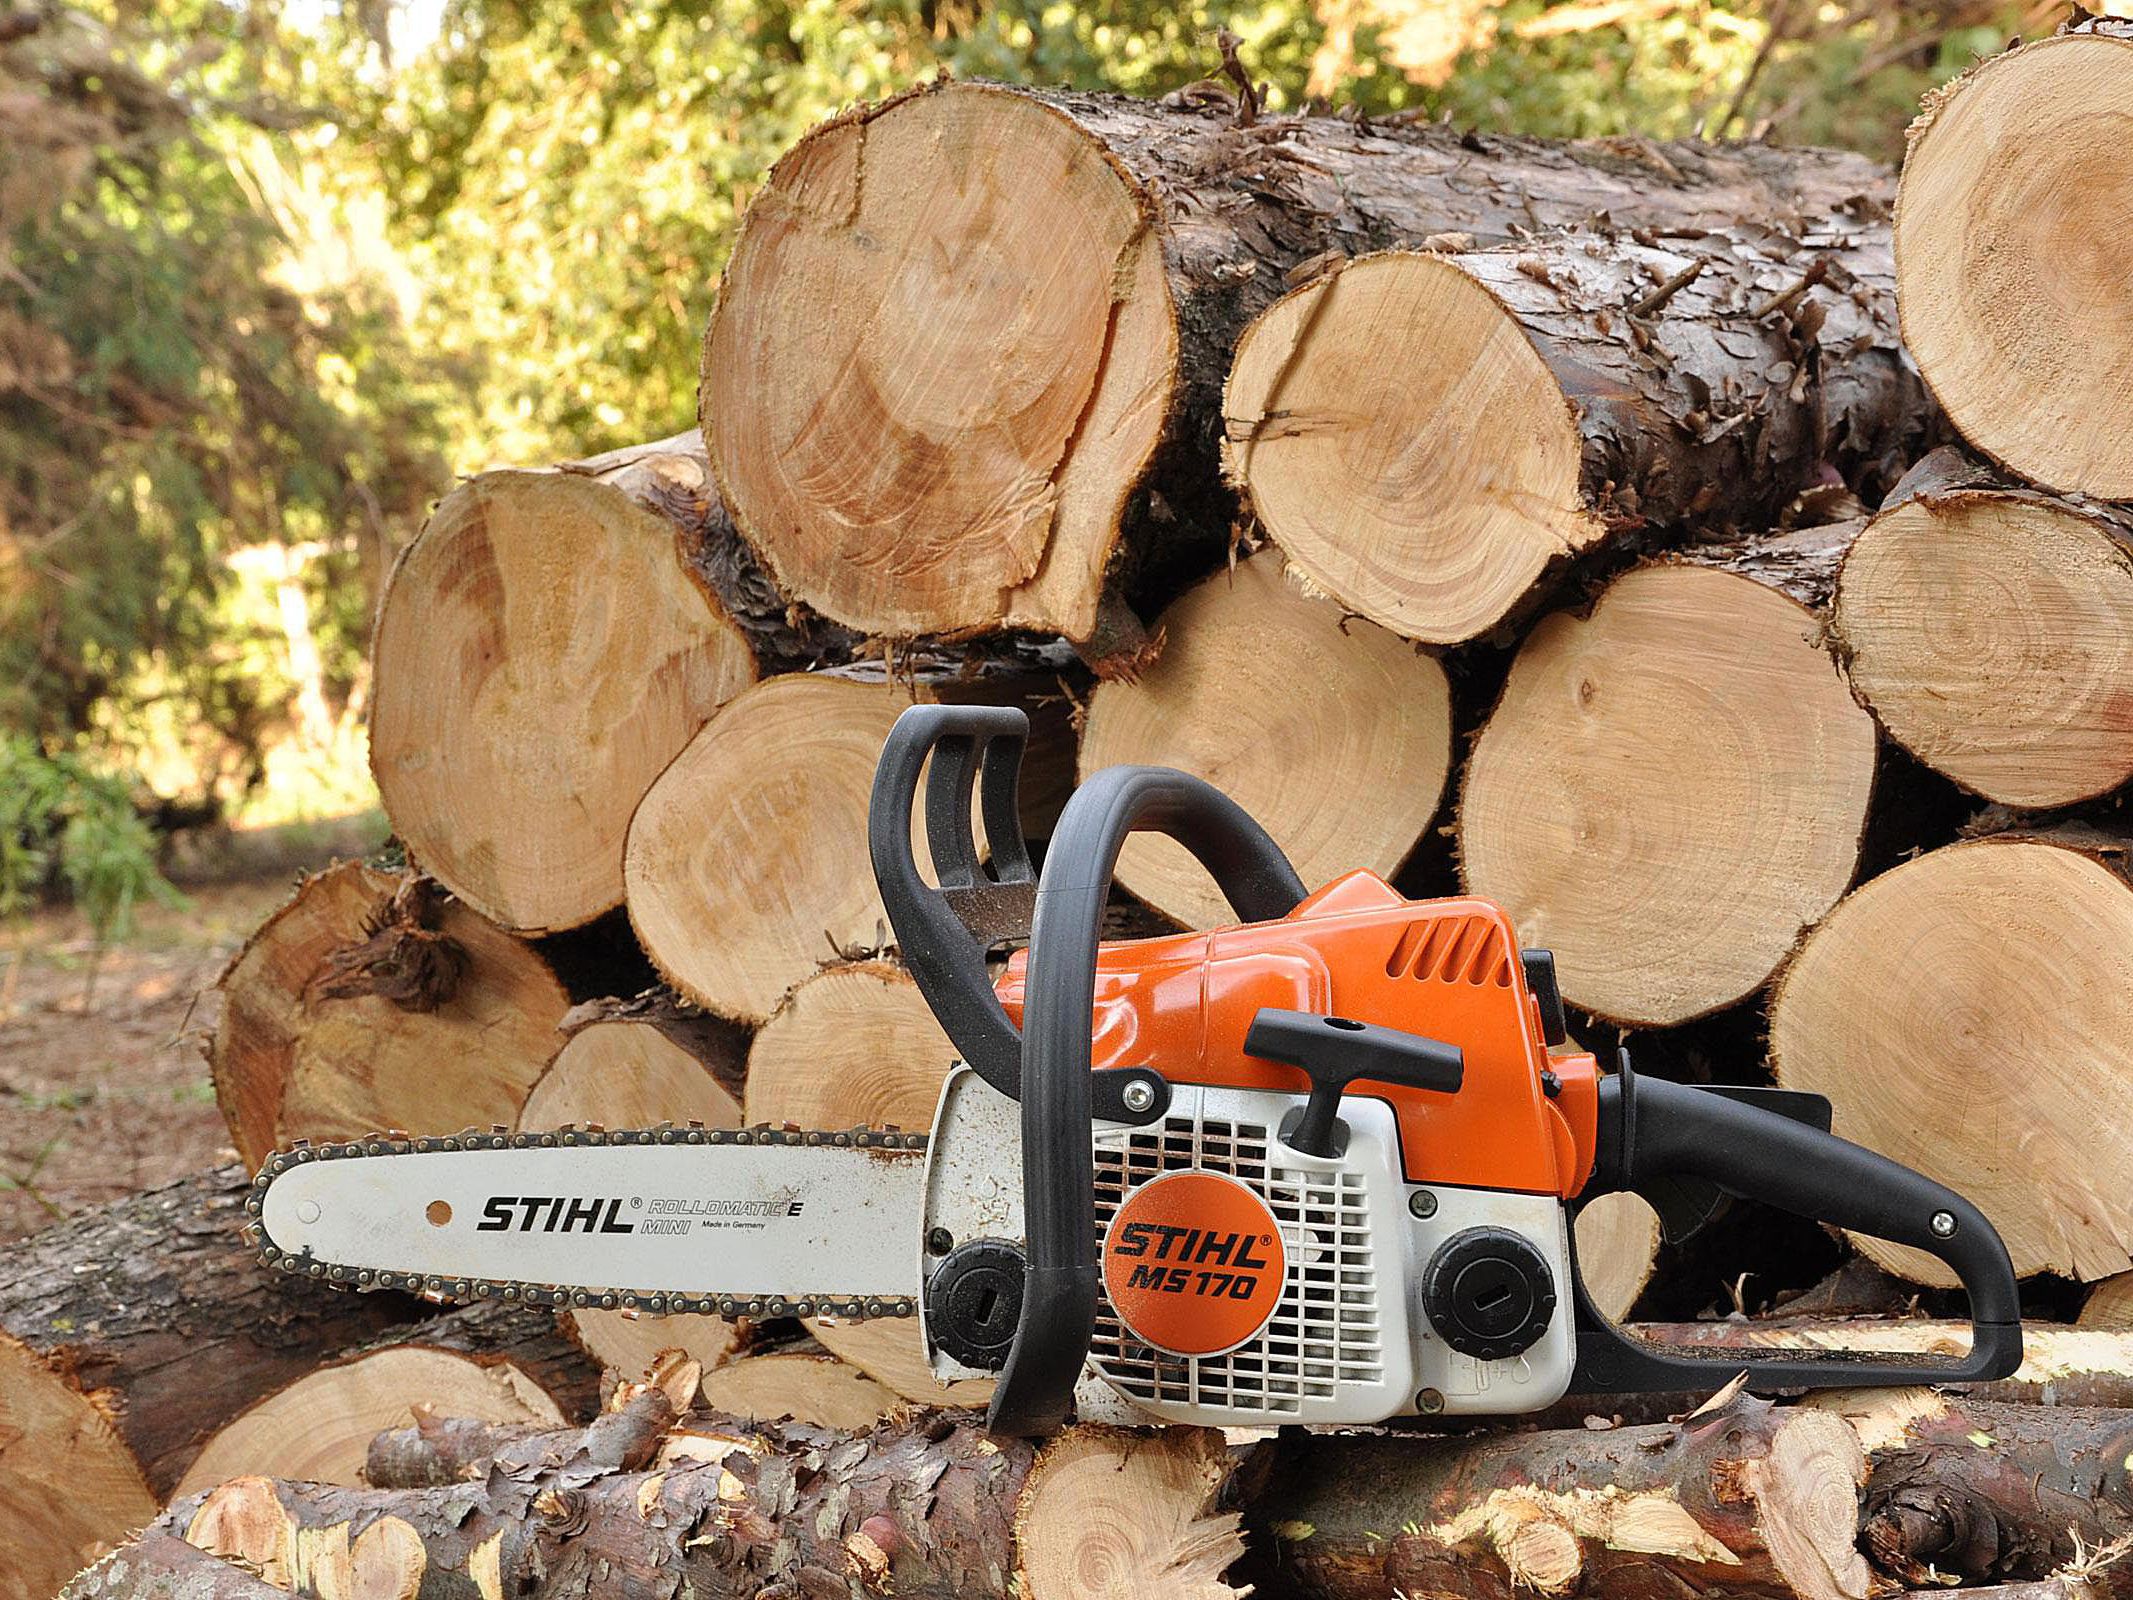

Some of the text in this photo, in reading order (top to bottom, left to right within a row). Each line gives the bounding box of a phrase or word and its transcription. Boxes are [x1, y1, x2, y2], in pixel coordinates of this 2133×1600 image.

[648, 1199, 804, 1217] ROLLOMATIC E
[640, 1219, 692, 1235] MINI
[702, 1220, 766, 1231] Made in Germany
[1127, 1265, 1258, 1299] MS 170
